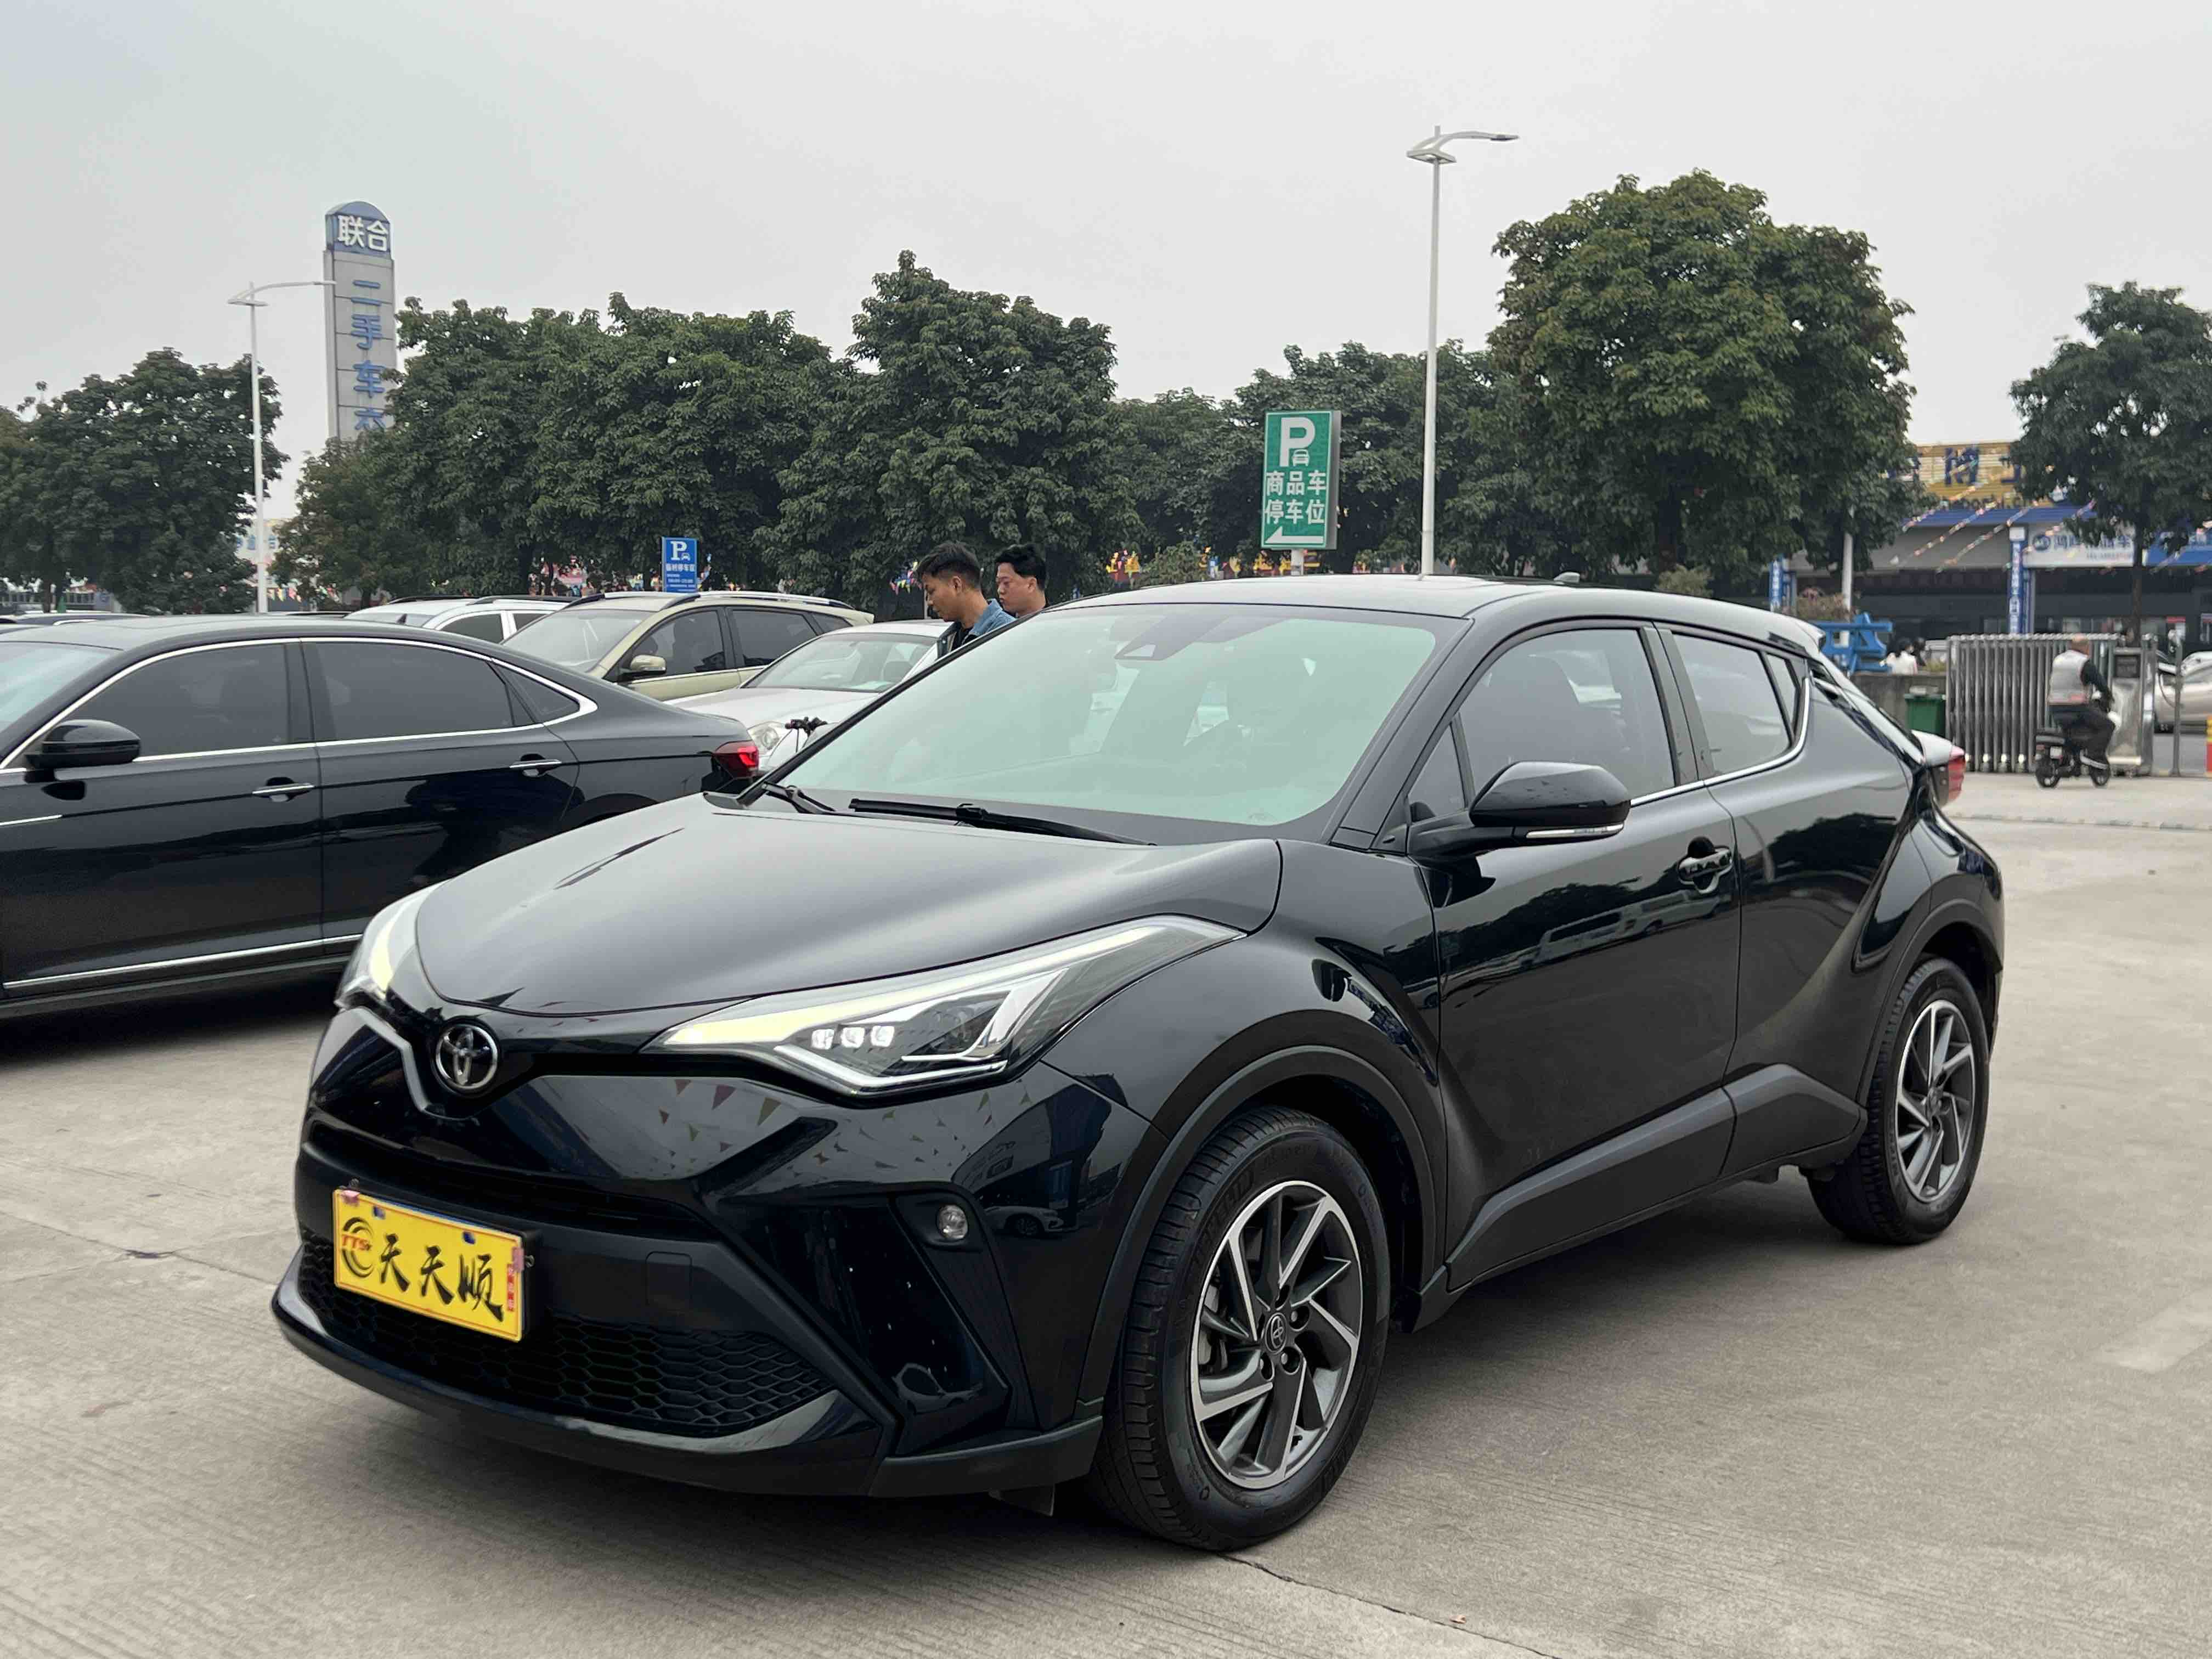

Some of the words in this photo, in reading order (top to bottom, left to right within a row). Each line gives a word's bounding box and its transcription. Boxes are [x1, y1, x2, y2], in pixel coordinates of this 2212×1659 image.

[337, 215, 388, 252] 联合
[1279, 416, 1316, 467] P
[1265, 470, 1327, 496] 商品车
[1264, 499, 1325, 524] 停车位
[670, 540, 687, 561] P
[380, 1233, 504, 1322] 天天顺
